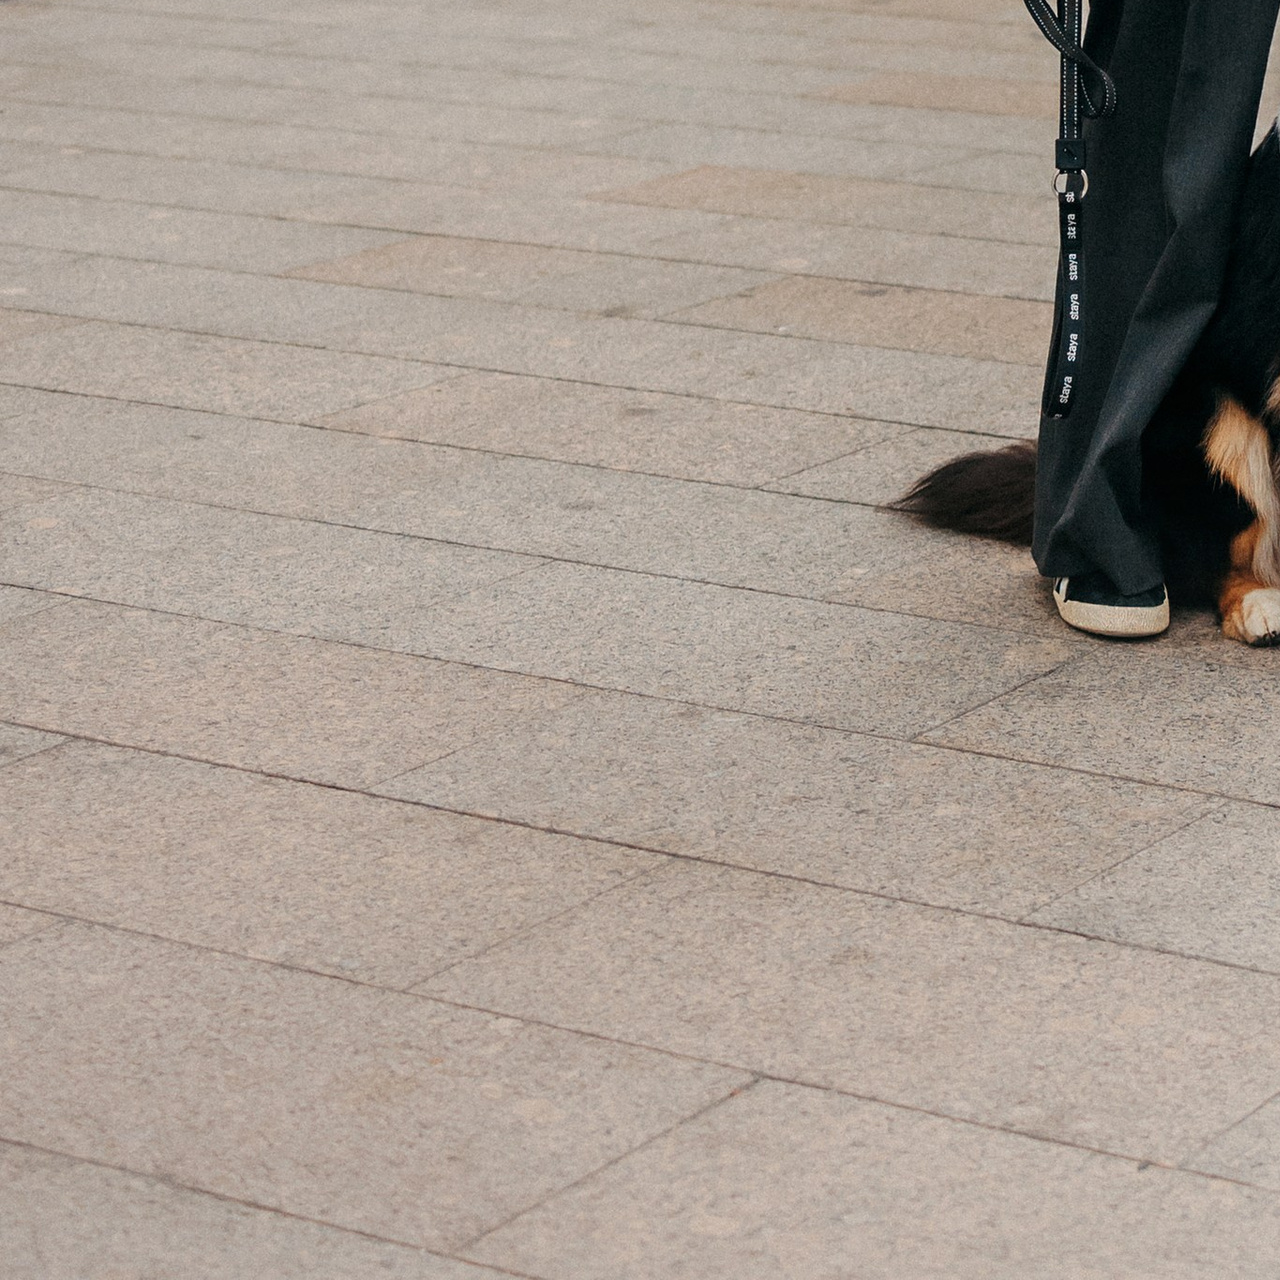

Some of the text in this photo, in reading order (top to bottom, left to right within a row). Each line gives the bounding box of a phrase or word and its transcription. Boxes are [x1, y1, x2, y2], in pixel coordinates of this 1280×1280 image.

[1068, 253, 1079, 281] staya
[1069, 293, 1080, 320] staya
[1066, 333, 1079, 362] staya
[1059, 376, 1073, 404] staya
